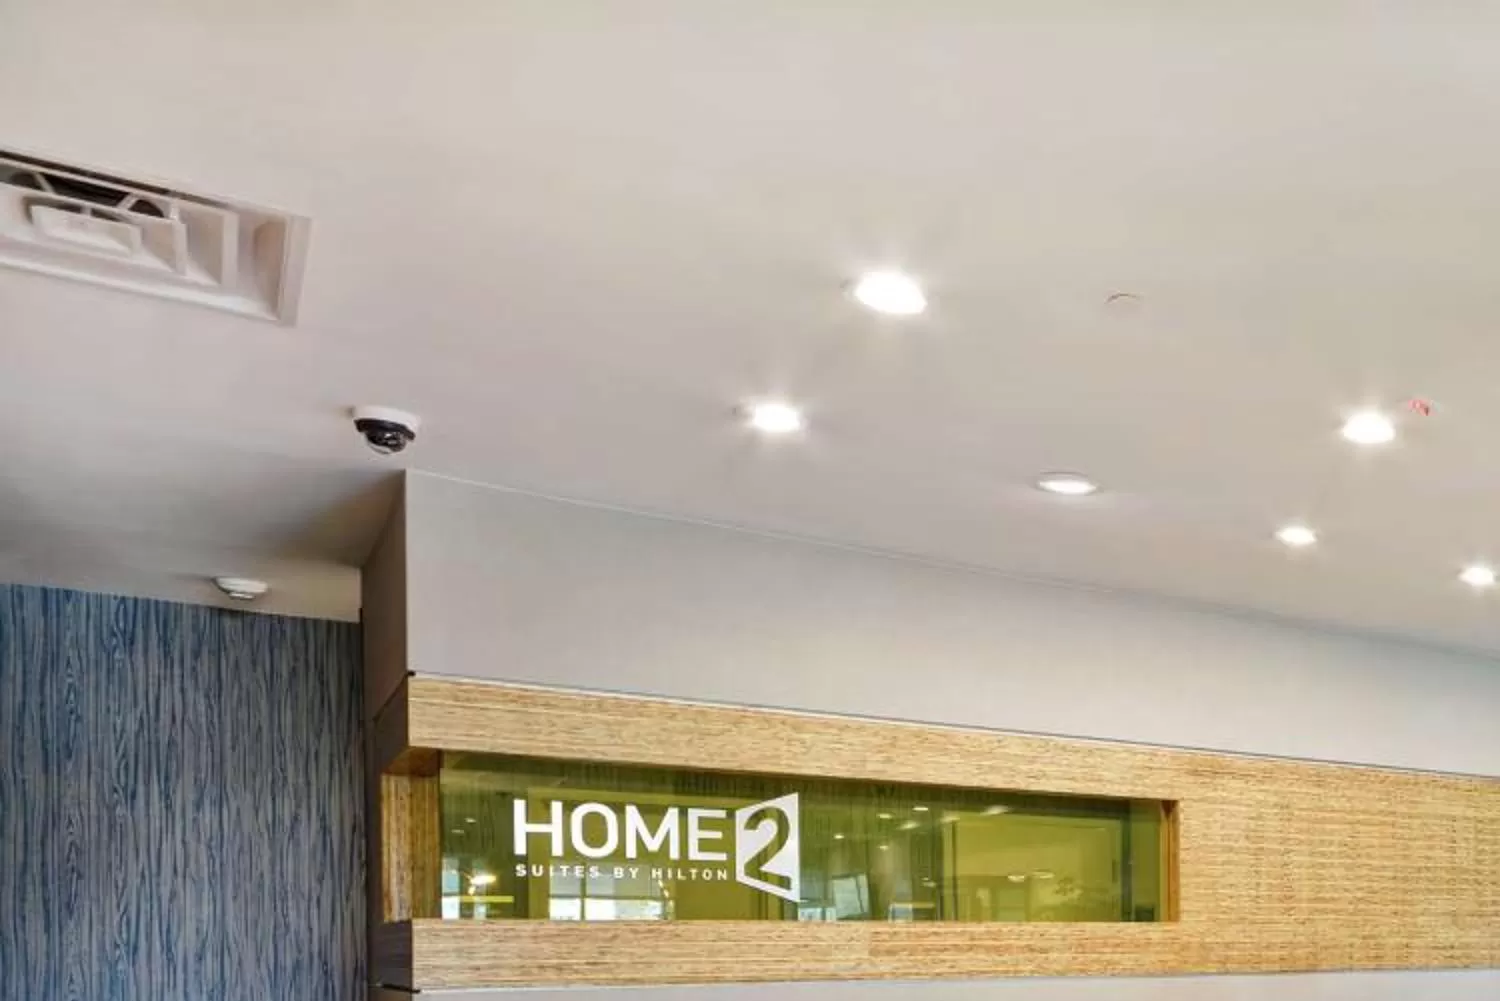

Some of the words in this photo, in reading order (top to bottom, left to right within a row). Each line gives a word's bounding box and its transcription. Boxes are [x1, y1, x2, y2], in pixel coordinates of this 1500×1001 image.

[515, 863, 600, 879] SUITES
[613, 866, 640, 879] BY
[651, 867, 728, 881] HILTON
